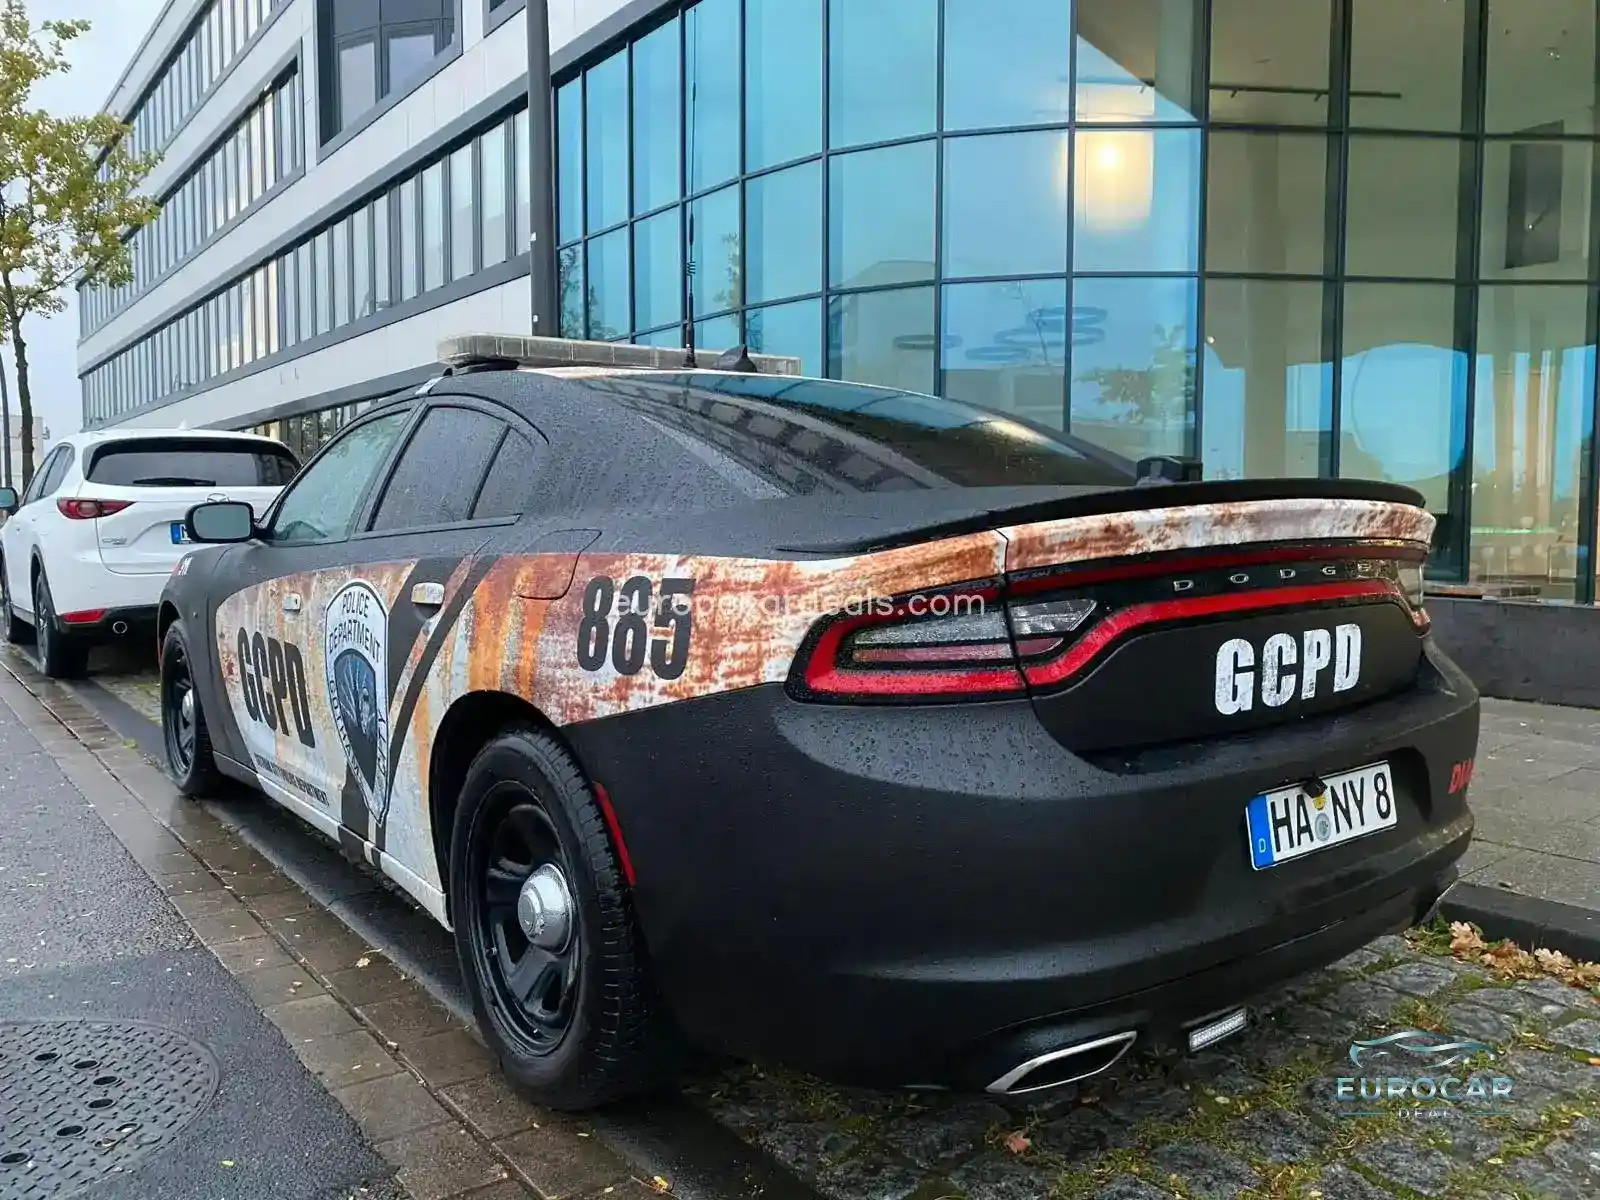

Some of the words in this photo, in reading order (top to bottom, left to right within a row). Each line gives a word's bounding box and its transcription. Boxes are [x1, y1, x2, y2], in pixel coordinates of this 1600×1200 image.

[342, 591, 370, 618] POLICE
[1173, 563, 1371, 591] DODGE
[329, 619, 380, 663] DEPARTMENT
[576, 576, 696, 680] 885
[237, 627, 316, 749] GCPD
[1215, 623, 1363, 716] GCPD
[1270, 794, 1314, 852] HA
[1329, 777, 1366, 833] NY
[1373, 772, 1391, 820] 8
